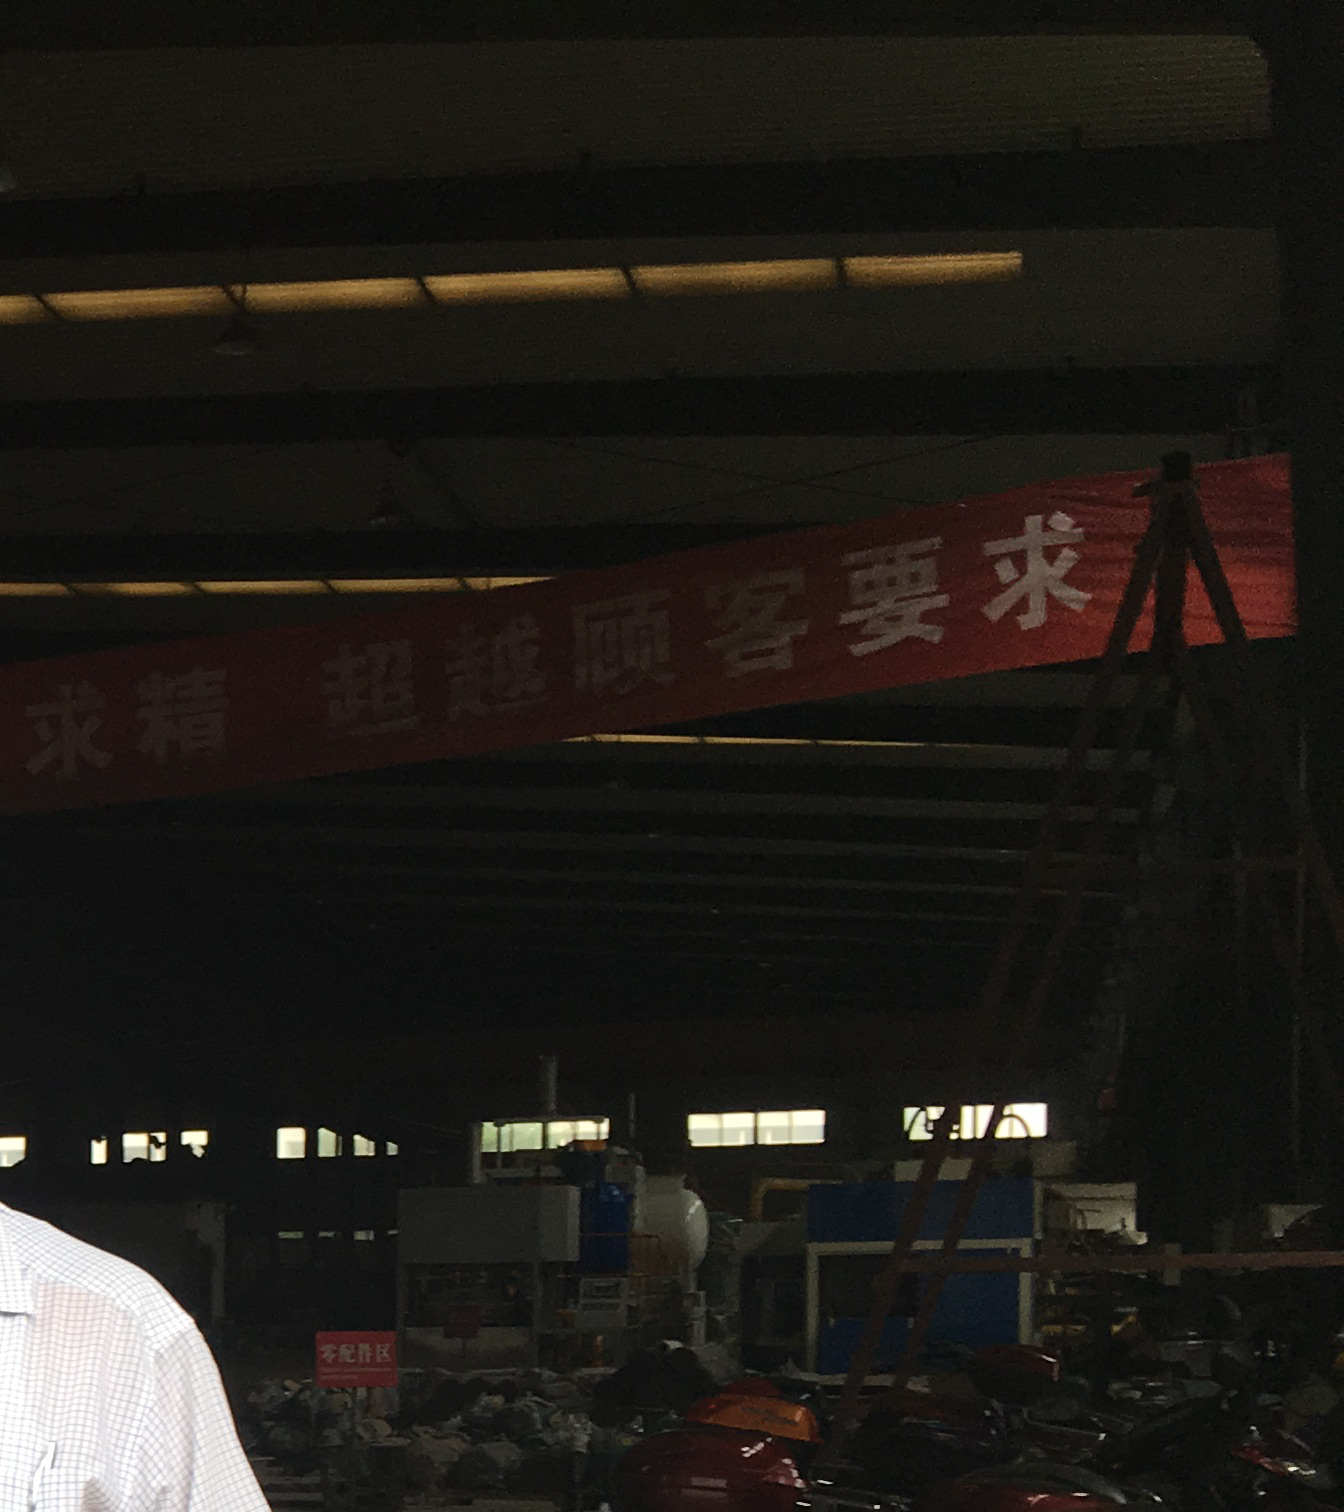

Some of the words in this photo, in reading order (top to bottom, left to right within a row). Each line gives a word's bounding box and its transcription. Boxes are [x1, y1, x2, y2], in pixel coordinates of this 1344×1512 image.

[319, 510, 1095, 740] 超越顾客要求
